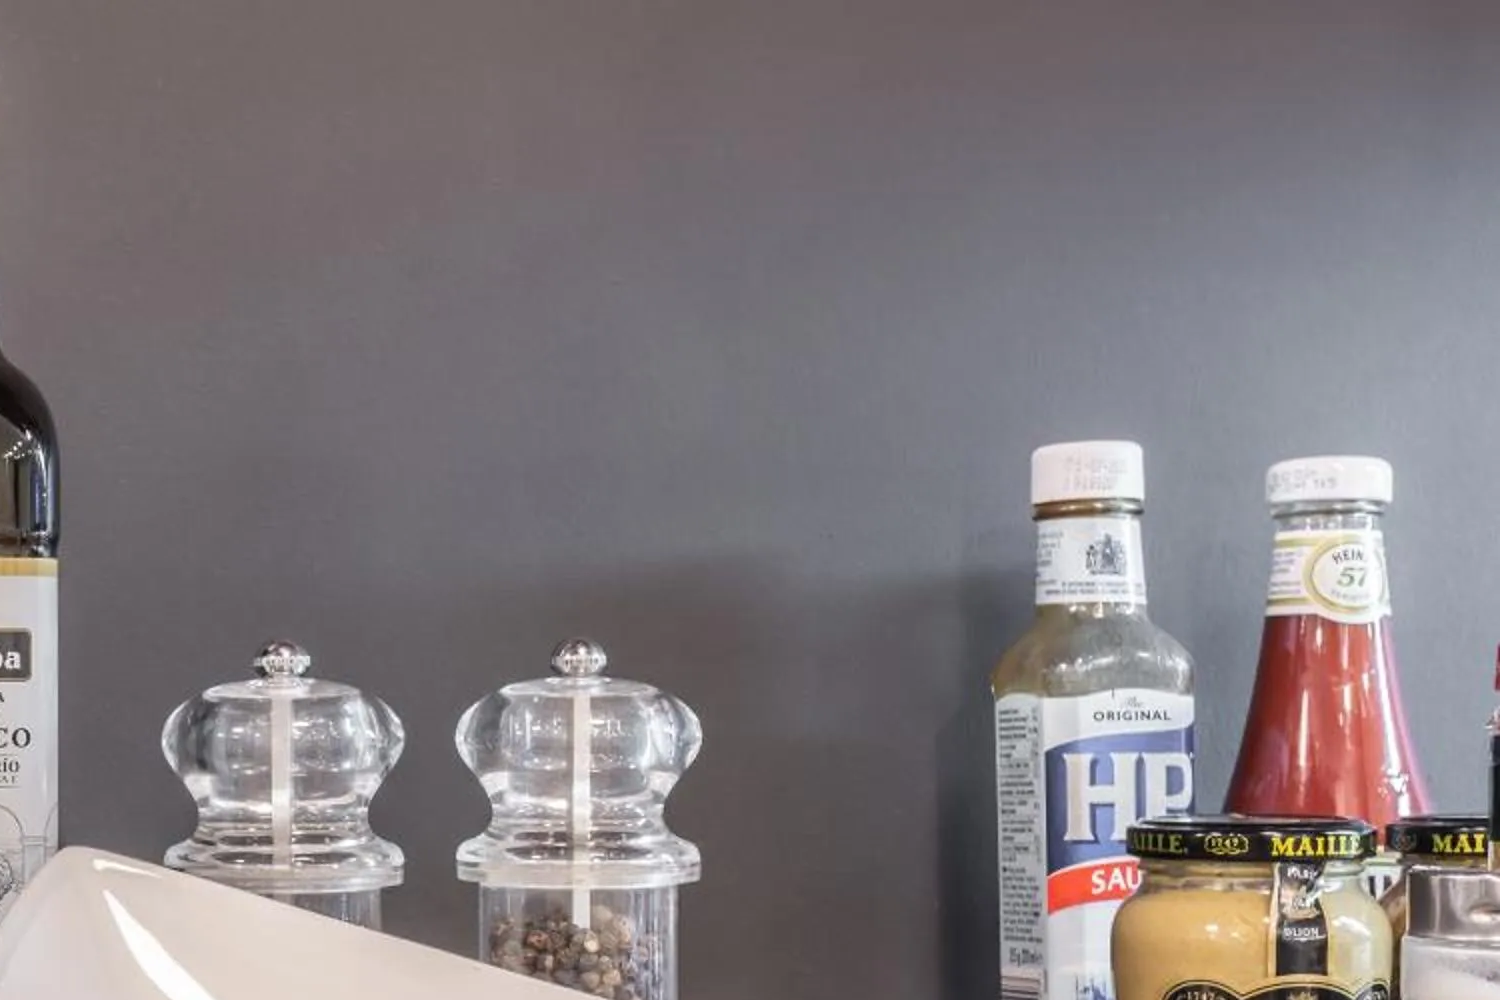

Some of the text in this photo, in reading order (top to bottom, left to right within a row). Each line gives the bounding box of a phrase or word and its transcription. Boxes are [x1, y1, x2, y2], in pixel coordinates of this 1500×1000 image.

[1332, 549, 1365, 565] HEIN
[1337, 567, 1368, 587] 57
[1092, 709, 1173, 723] ORIGINAL
[1062, 752, 1194, 841] HP
[1270, 832, 1362, 857] MAILLE
[1431, 832, 1487, 854] MAI
[1091, 867, 1143, 895] SAU
